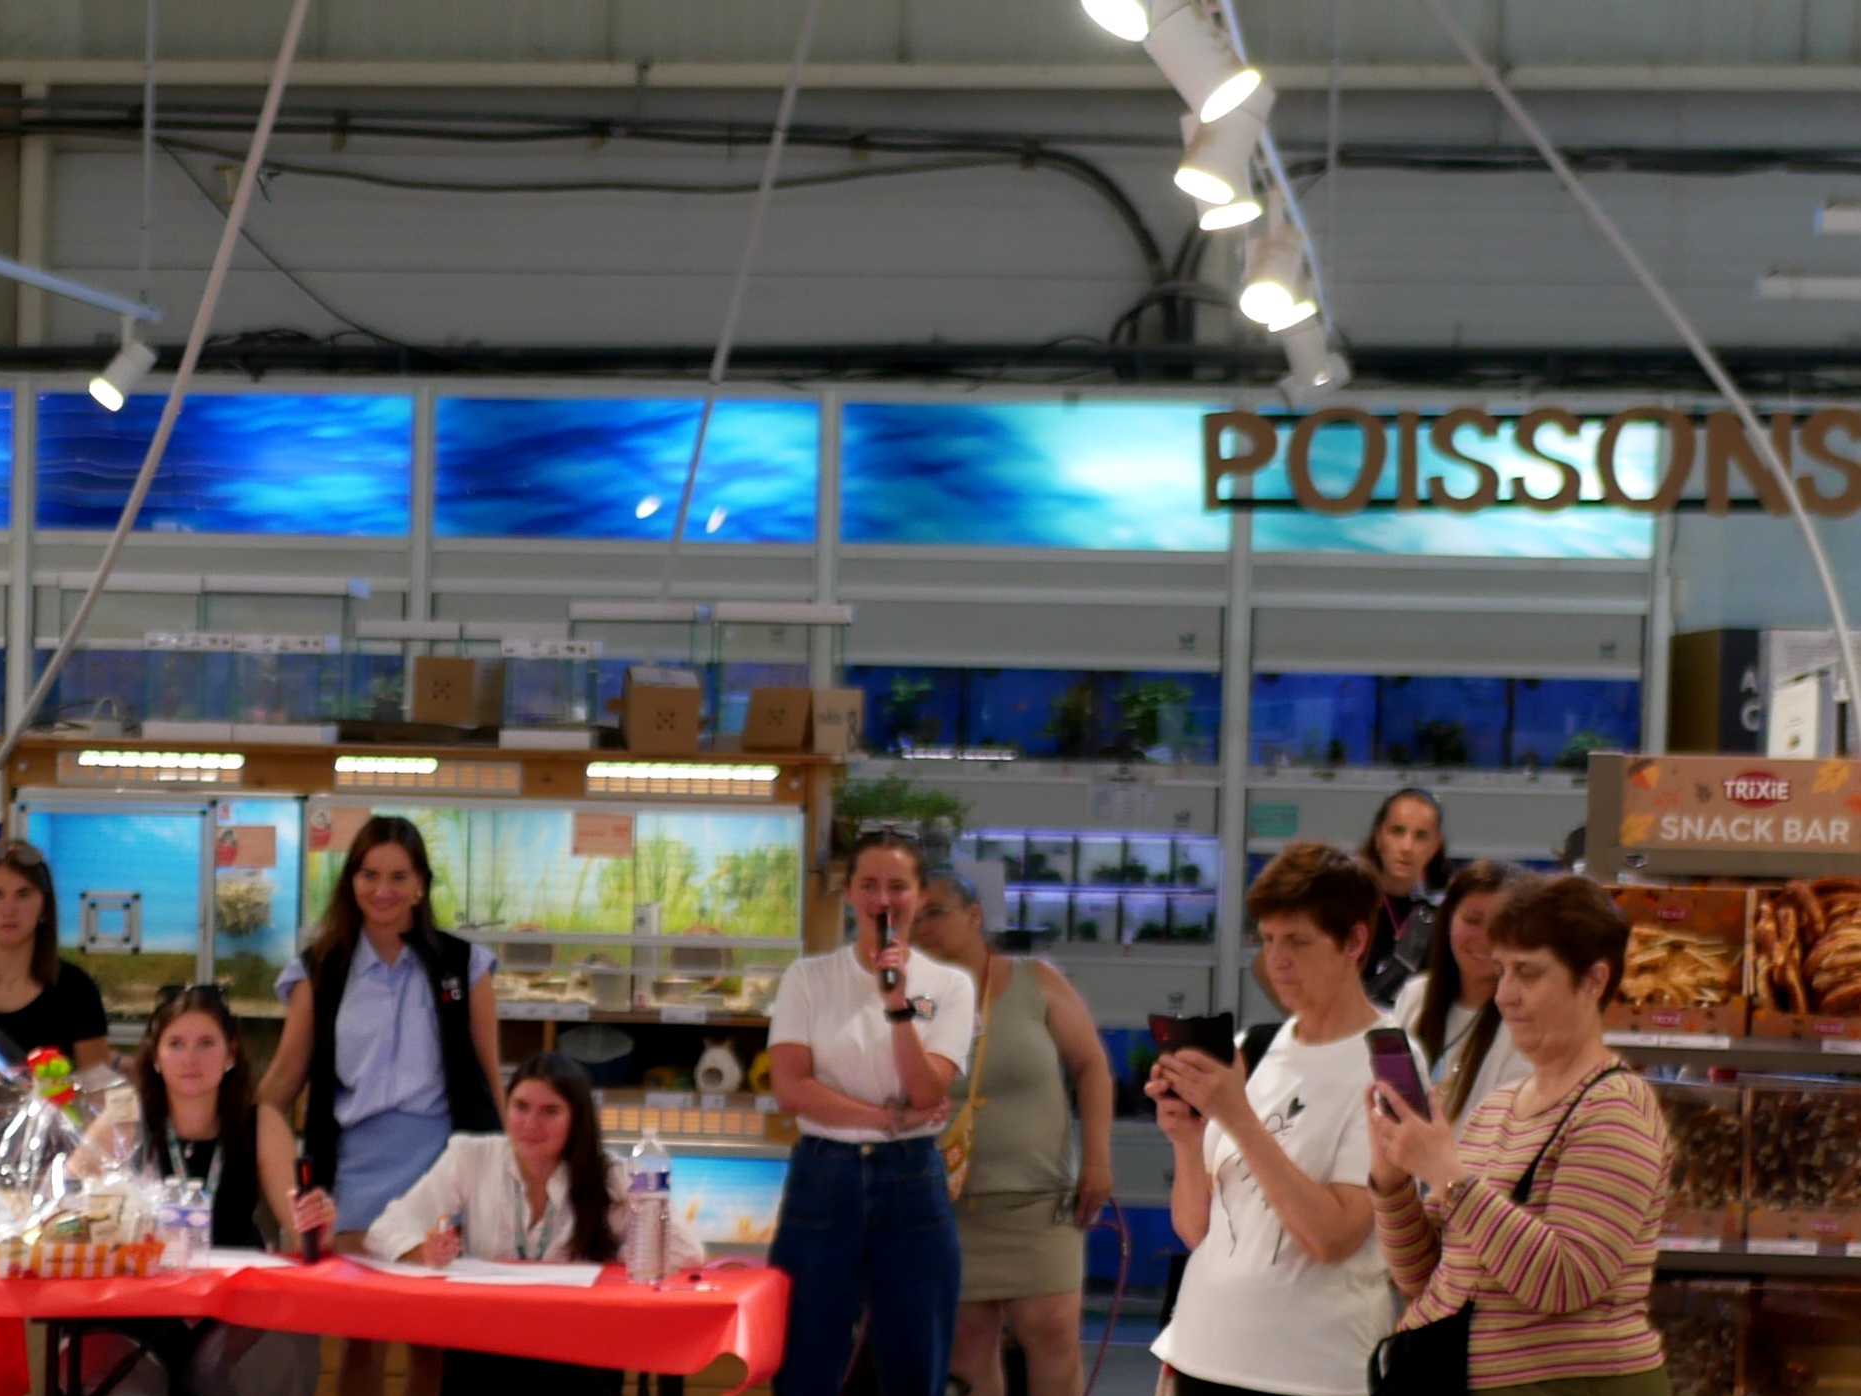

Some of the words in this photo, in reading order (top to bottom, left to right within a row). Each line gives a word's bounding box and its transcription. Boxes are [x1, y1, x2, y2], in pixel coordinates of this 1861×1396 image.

[1204, 407, 1861, 516] POISSONS
[1660, 814, 1773, 843] SNACK
[1782, 817, 1850, 845] BAR
